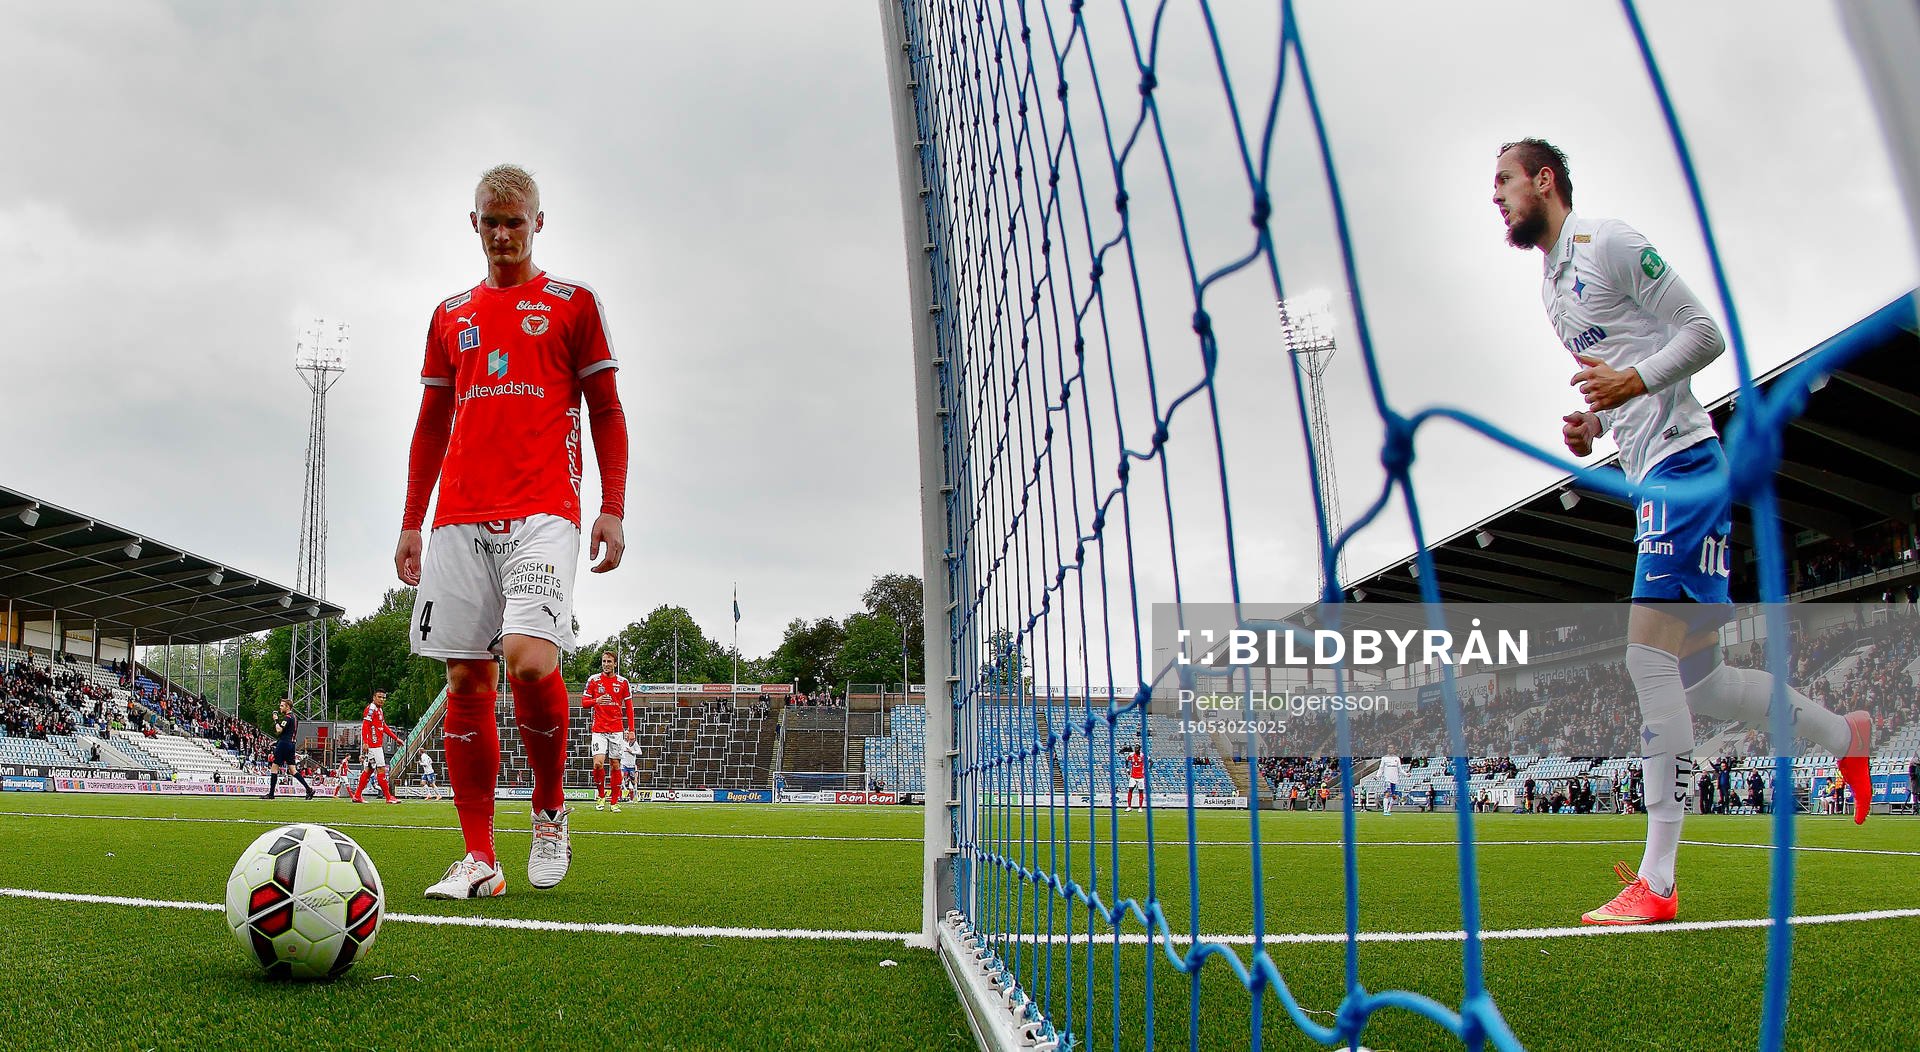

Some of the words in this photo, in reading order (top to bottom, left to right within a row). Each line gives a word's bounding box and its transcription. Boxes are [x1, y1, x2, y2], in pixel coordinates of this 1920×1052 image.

[515, 300, 552, 312] Electra
[1699, 534, 1730, 577] nt
[420, 601, 433, 641] 4
[23, 765, 39, 777] kvm
[138, 772, 151, 781] kvm
[727, 792, 762, 801] Bygg-Ole
